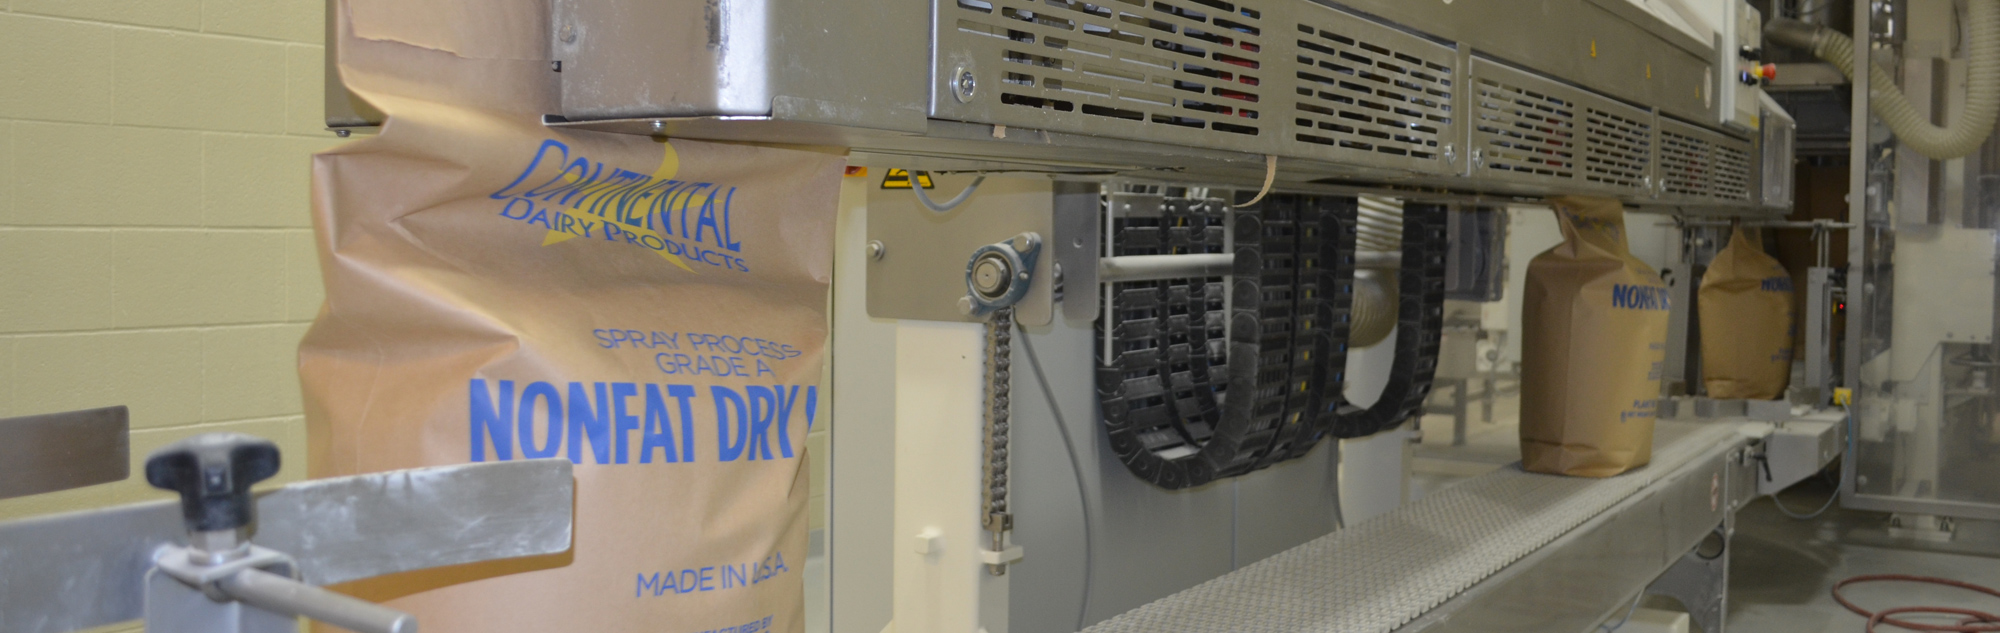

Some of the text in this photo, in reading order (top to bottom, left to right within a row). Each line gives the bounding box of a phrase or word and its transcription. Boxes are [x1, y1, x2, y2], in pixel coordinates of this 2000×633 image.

[489, 138, 742, 253] CONTINENTAL
[498, 197, 750, 273] DAIRY PRODUCTS
[593, 328, 802, 360] SPRAY PROCESS
[655, 352, 776, 377] GRADE A
[469, 378, 697, 464] NONFAT
[709, 384, 800, 462] DRY
[636, 566, 716, 598] MADE
[721, 562, 747, 589] IN
